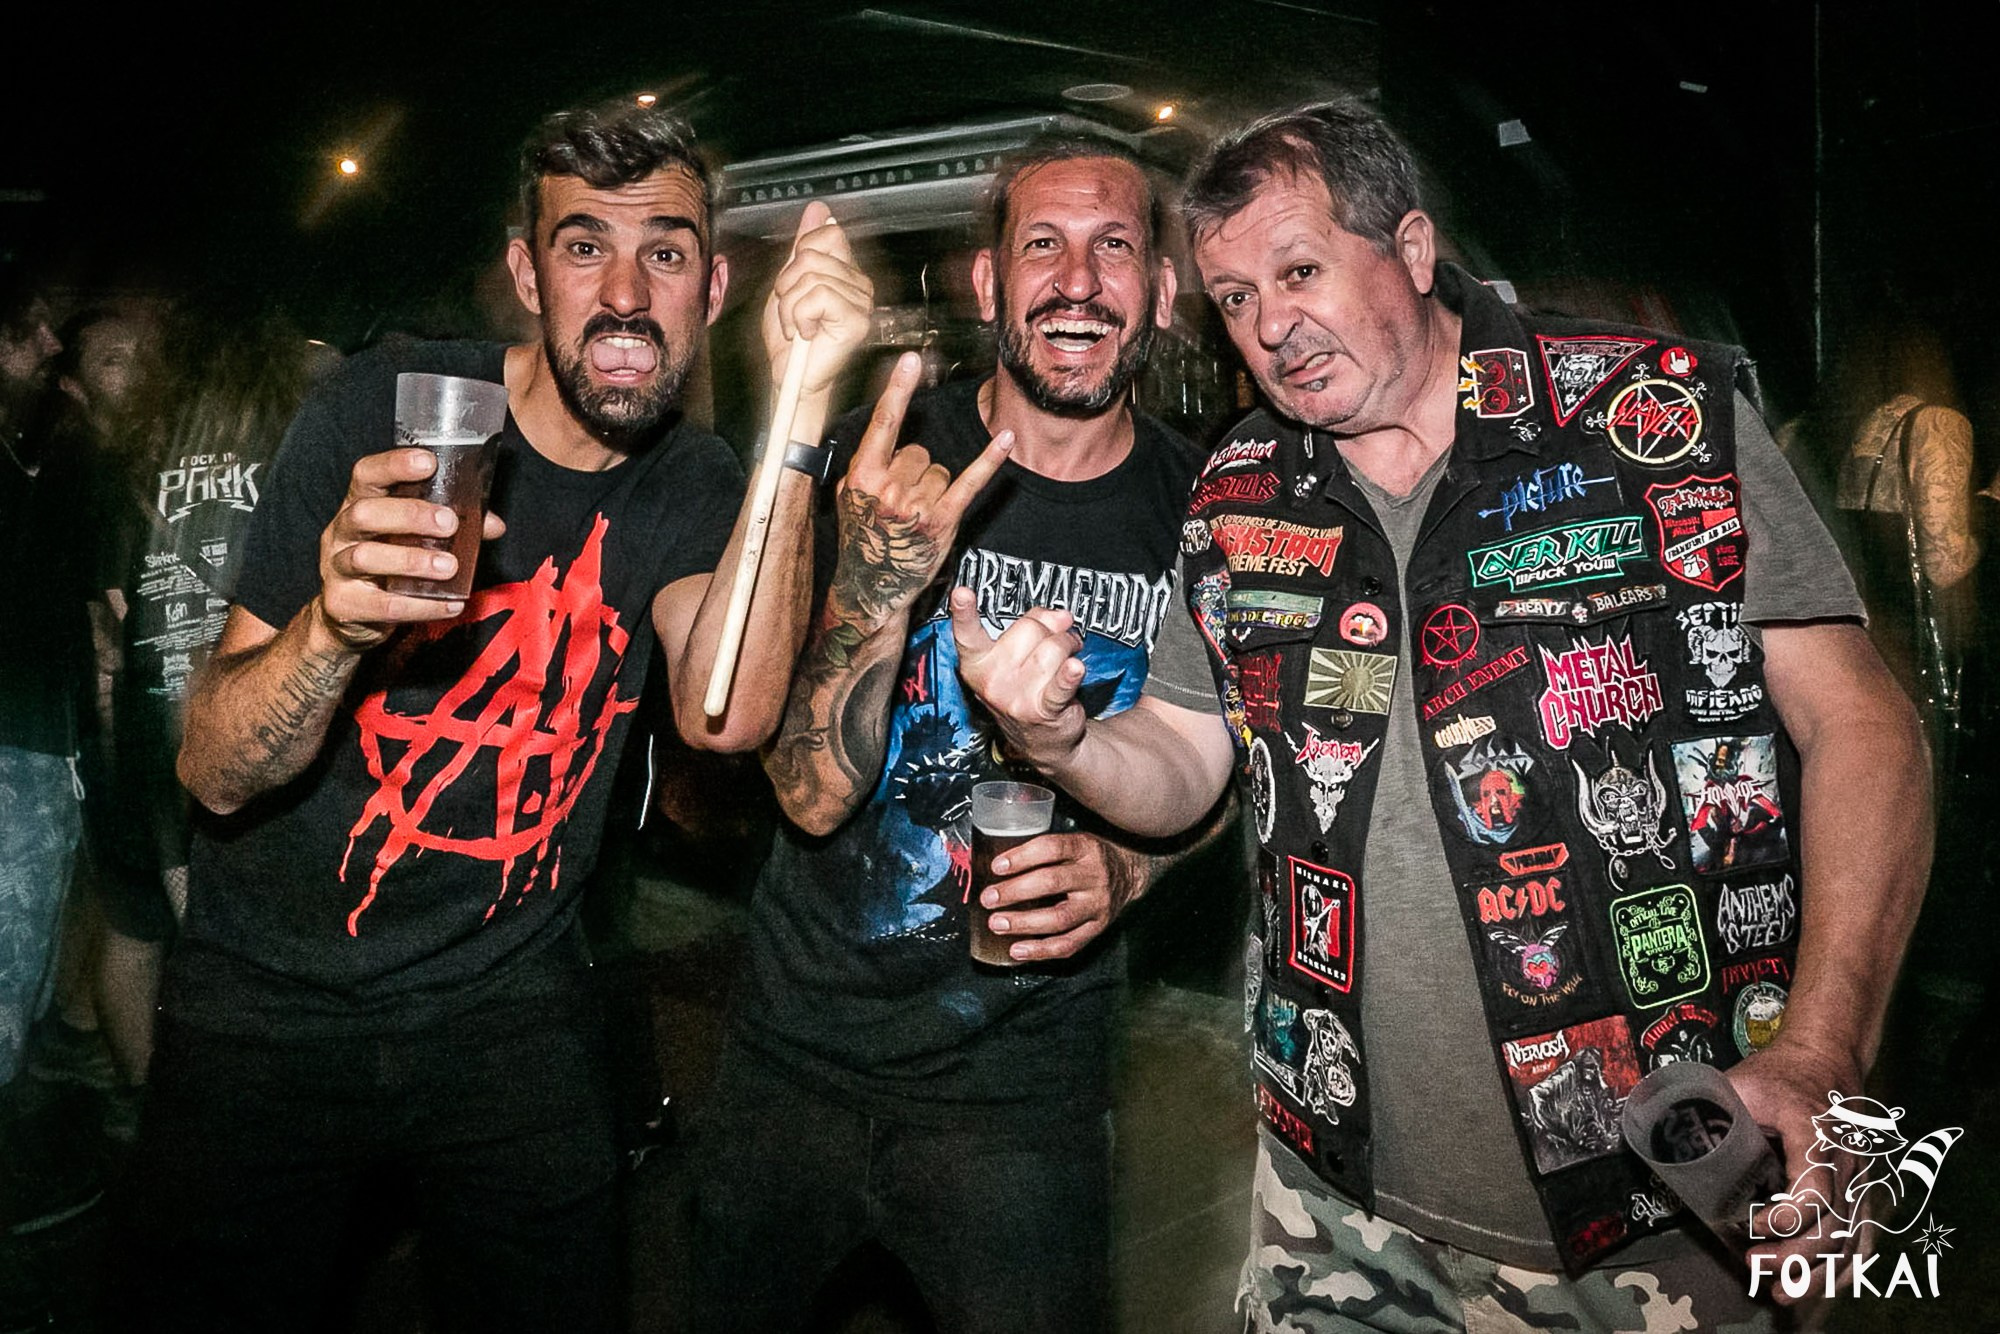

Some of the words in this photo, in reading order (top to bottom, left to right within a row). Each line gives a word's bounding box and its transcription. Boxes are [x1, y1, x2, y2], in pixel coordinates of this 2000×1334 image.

[1607, 391, 1700, 441] SLAYER
[157, 462, 262, 520] PARK
[1264, 517, 1278, 528] OF
[1228, 555, 1269, 573] TREME
[1268, 557, 1309, 577] FEST
[948, 548, 1178, 656] OREMAGEDDO
[1514, 601, 1566, 617] HEAVY
[1422, 682, 1468, 721] ARCH
[1469, 645, 1531, 692] ENEMY
[1538, 634, 1648, 694] METAL
[1538, 672, 1663, 750] CHURCH
[1717, 873, 1796, 933] ANTHEMS
[1631, 924, 1689, 960] PANTERA
[1726, 914, 1795, 955] STEEL
[1520, 994, 1538, 1007] ON
[1504, 1029, 1571, 1071] NERVOSA
